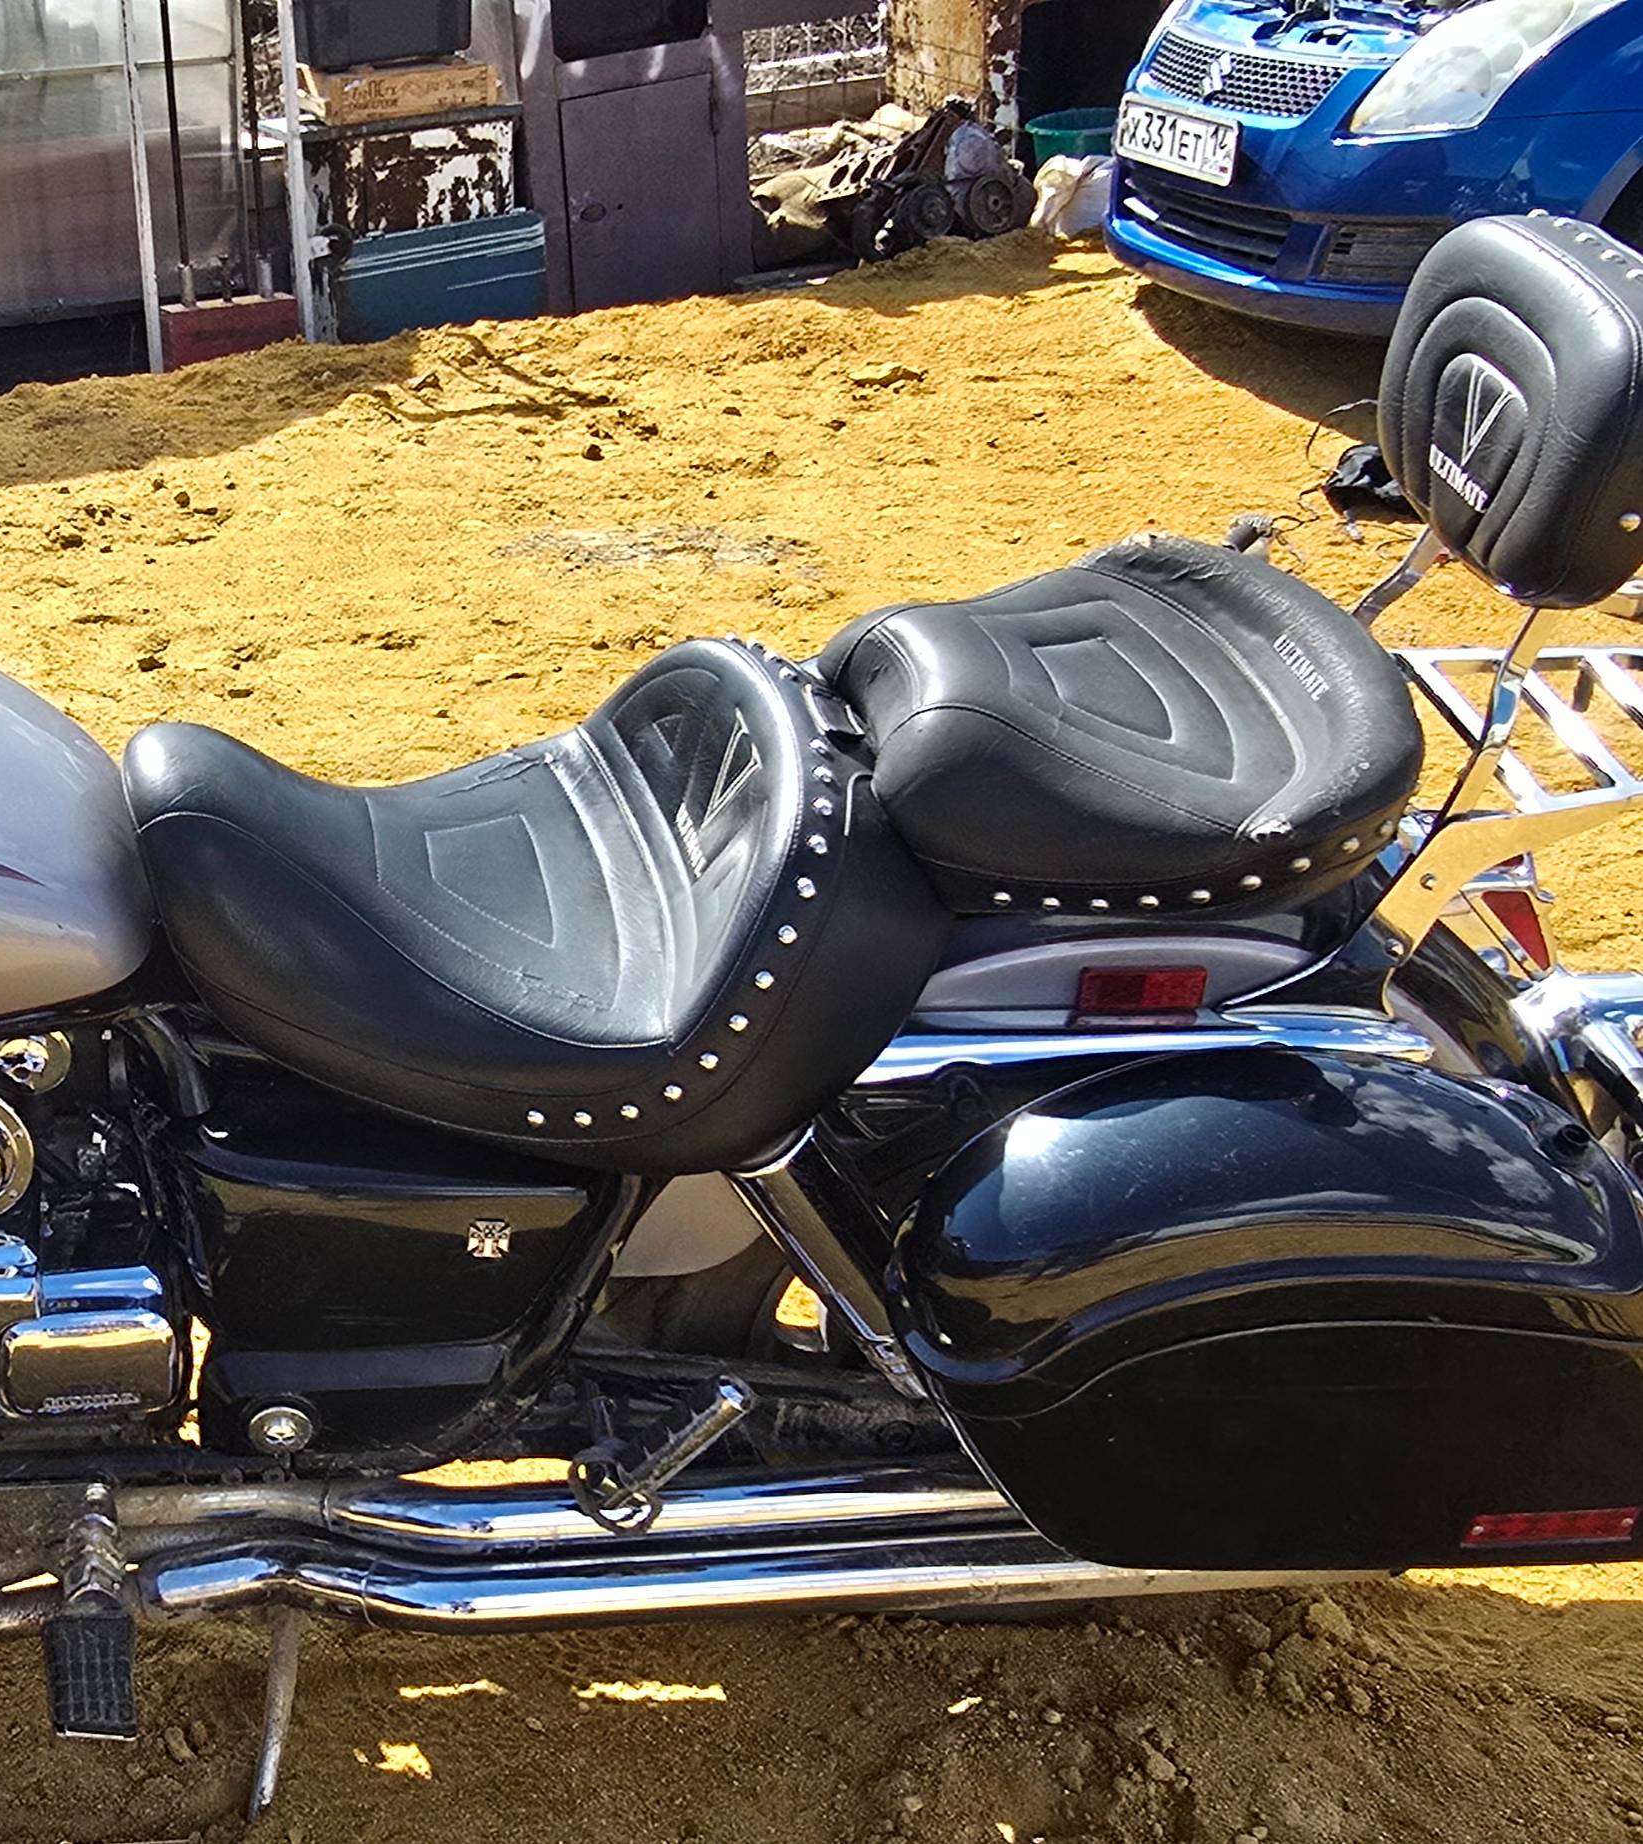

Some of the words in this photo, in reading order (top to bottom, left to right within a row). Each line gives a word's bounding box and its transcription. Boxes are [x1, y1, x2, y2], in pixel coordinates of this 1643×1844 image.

[1128, 111, 1202, 163] X331ET
[1428, 443, 1489, 514] ULTIMATE
[1272, 633, 1330, 702] ULTIMATE
